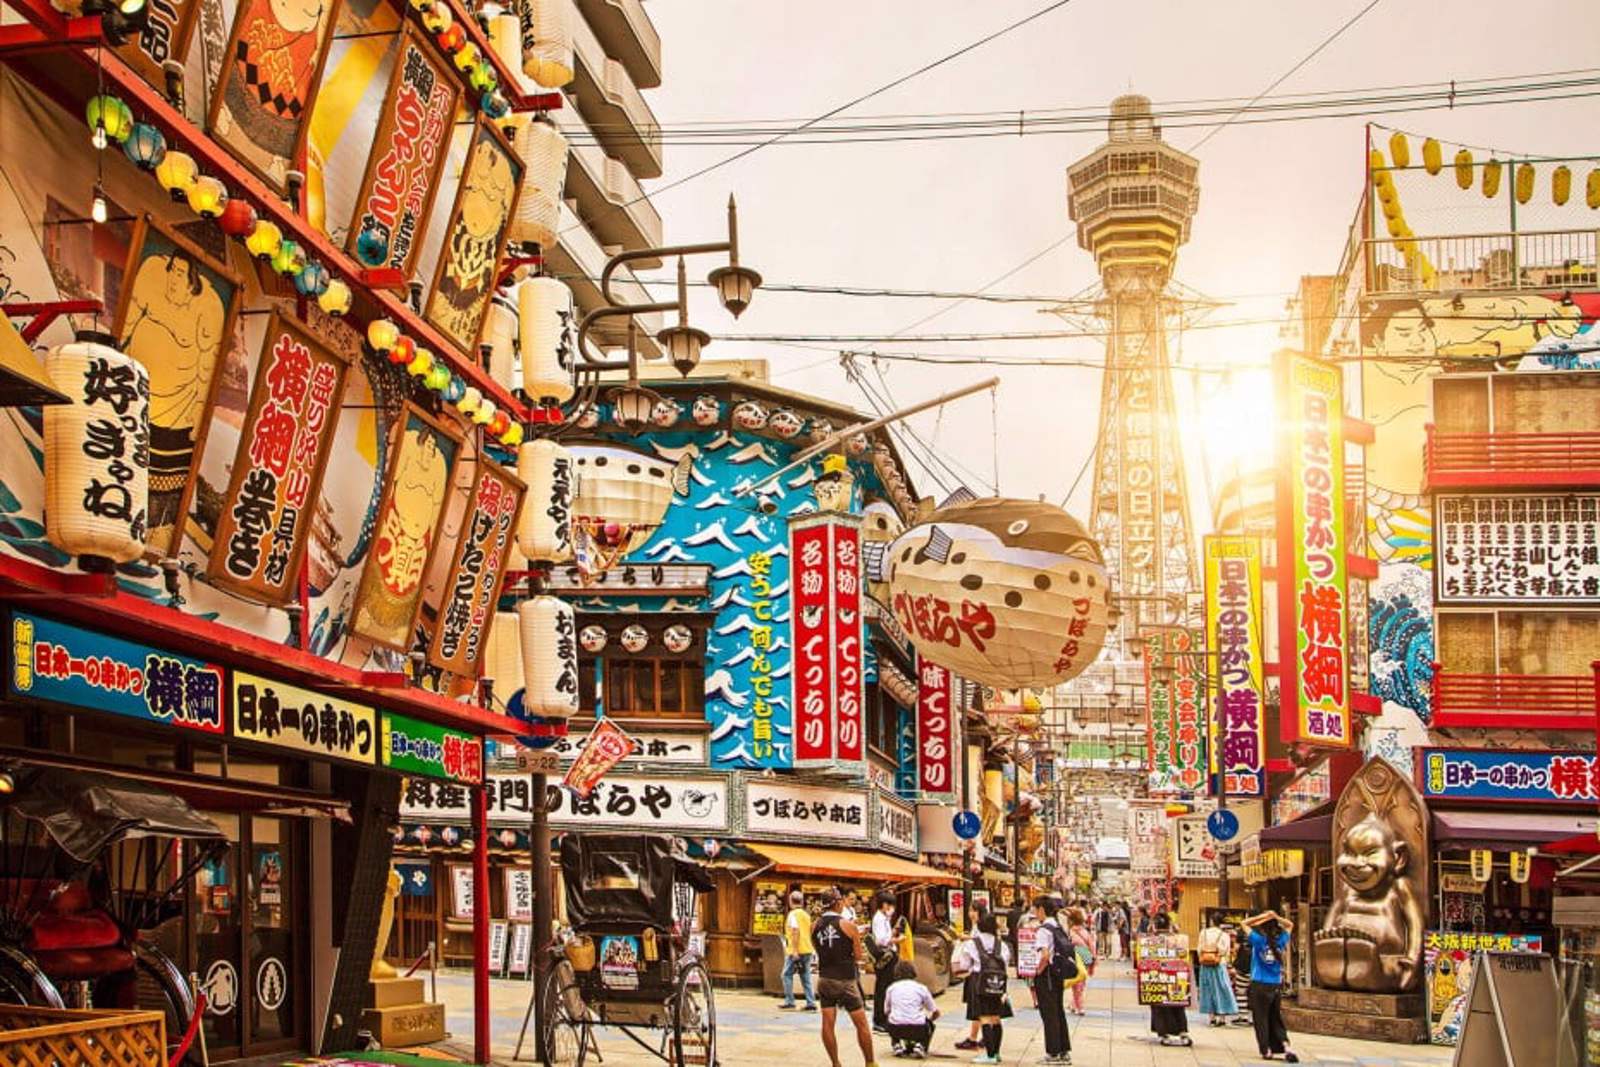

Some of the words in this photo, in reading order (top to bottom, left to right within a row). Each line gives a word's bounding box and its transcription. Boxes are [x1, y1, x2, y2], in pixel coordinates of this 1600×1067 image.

[226, 333, 313, 579] 横綱巻き
[263, 362, 336, 587] 盛り沢山具材
[1304, 394, 1334, 580] 日本一の串かつ
[440, 472, 504, 659] 揚げたこ焼き
[801, 540, 824, 596] 名物
[837, 540, 857, 596] 名物
[1219, 560, 1250, 685] 日本一の串かつ
[1300, 581, 1344, 707] 横綱
[34, 643, 143, 693] 日本一の串かつ
[144, 656, 222, 728] 横綱
[802, 635, 824, 748] てっちり
[837, 637, 858, 748] てっちり
[237, 684, 372, 755] 日本一の串かつ
[1214, 689, 1260, 772] 横綱
[1308, 711, 1343, 737] 酒処
[442, 733, 482, 783] 横綱
[1446, 762, 1548, 788] 日本一の串かつ
[753, 797, 862, 825] づぼらや本店
[1427, 934, 1513, 951] 大阪新世界
